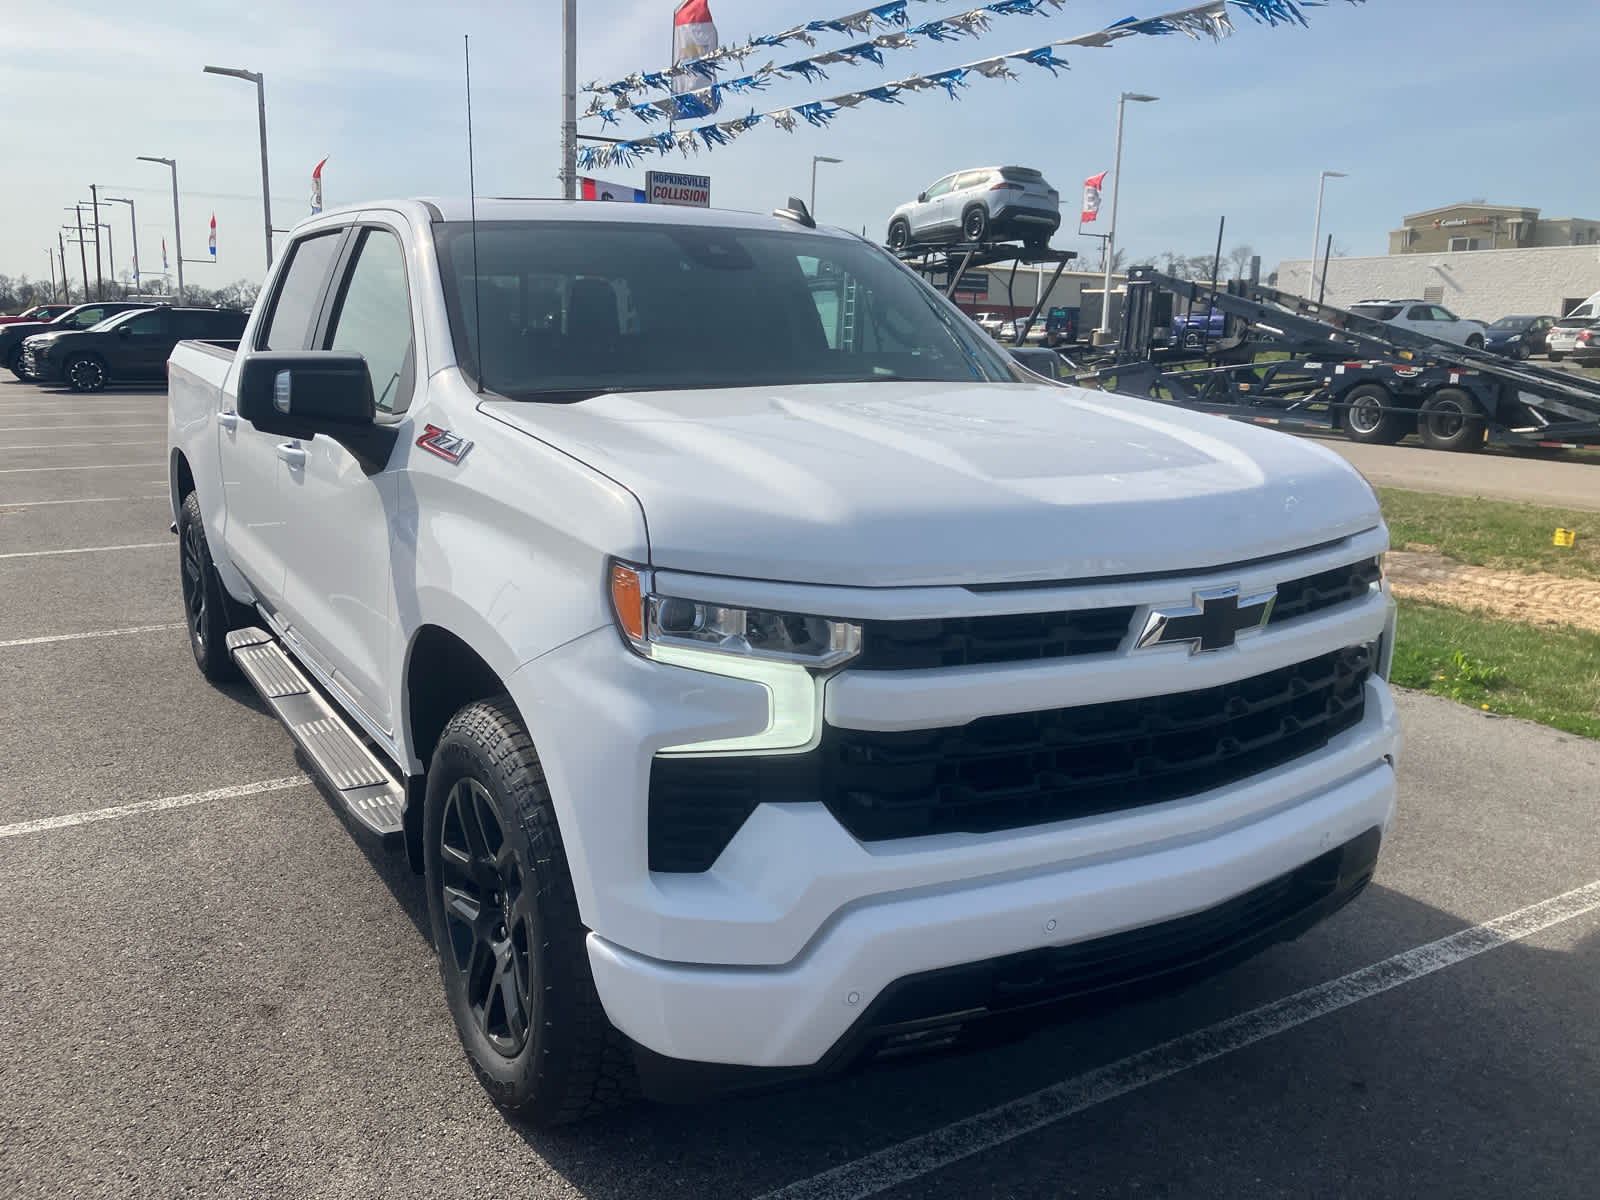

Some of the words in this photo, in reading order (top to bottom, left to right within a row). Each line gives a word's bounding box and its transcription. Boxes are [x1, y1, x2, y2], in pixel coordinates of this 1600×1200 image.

[653, 173, 708, 188] HOPKINSVILLE
[653, 186, 707, 202] COLLISION
[416, 424, 474, 466] Z71
